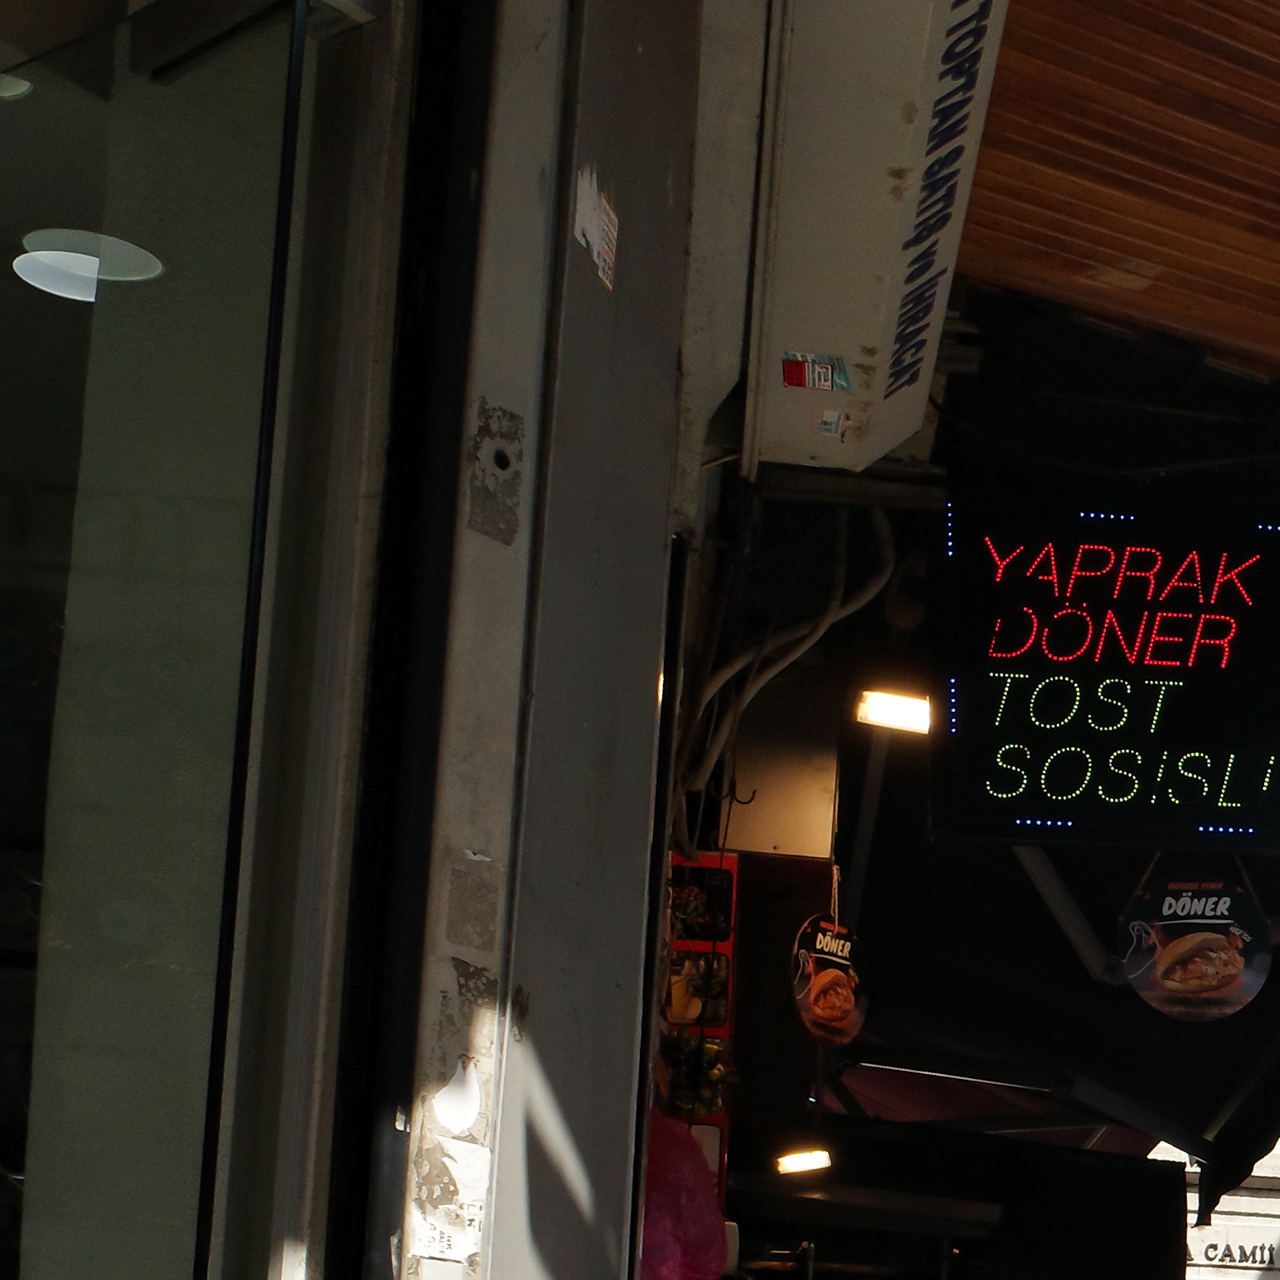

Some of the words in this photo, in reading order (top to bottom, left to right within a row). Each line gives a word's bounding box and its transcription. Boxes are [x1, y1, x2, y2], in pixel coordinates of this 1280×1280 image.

[924, 0, 992, 157] TOPTAN
[901, 144, 965, 252] SATIŞ
[904, 239, 939, 285] ve
[882, 266, 948, 401] İHRACAT
[984, 536, 1261, 606] YAPRAK
[988, 602, 1237, 669] DÖNER
[988, 671, 1184, 734] TOST
[1161, 891, 1232, 917] DÖNER
[815, 931, 852, 959] DÖNER
[1204, 1243, 1275, 1266] CAMİİ
